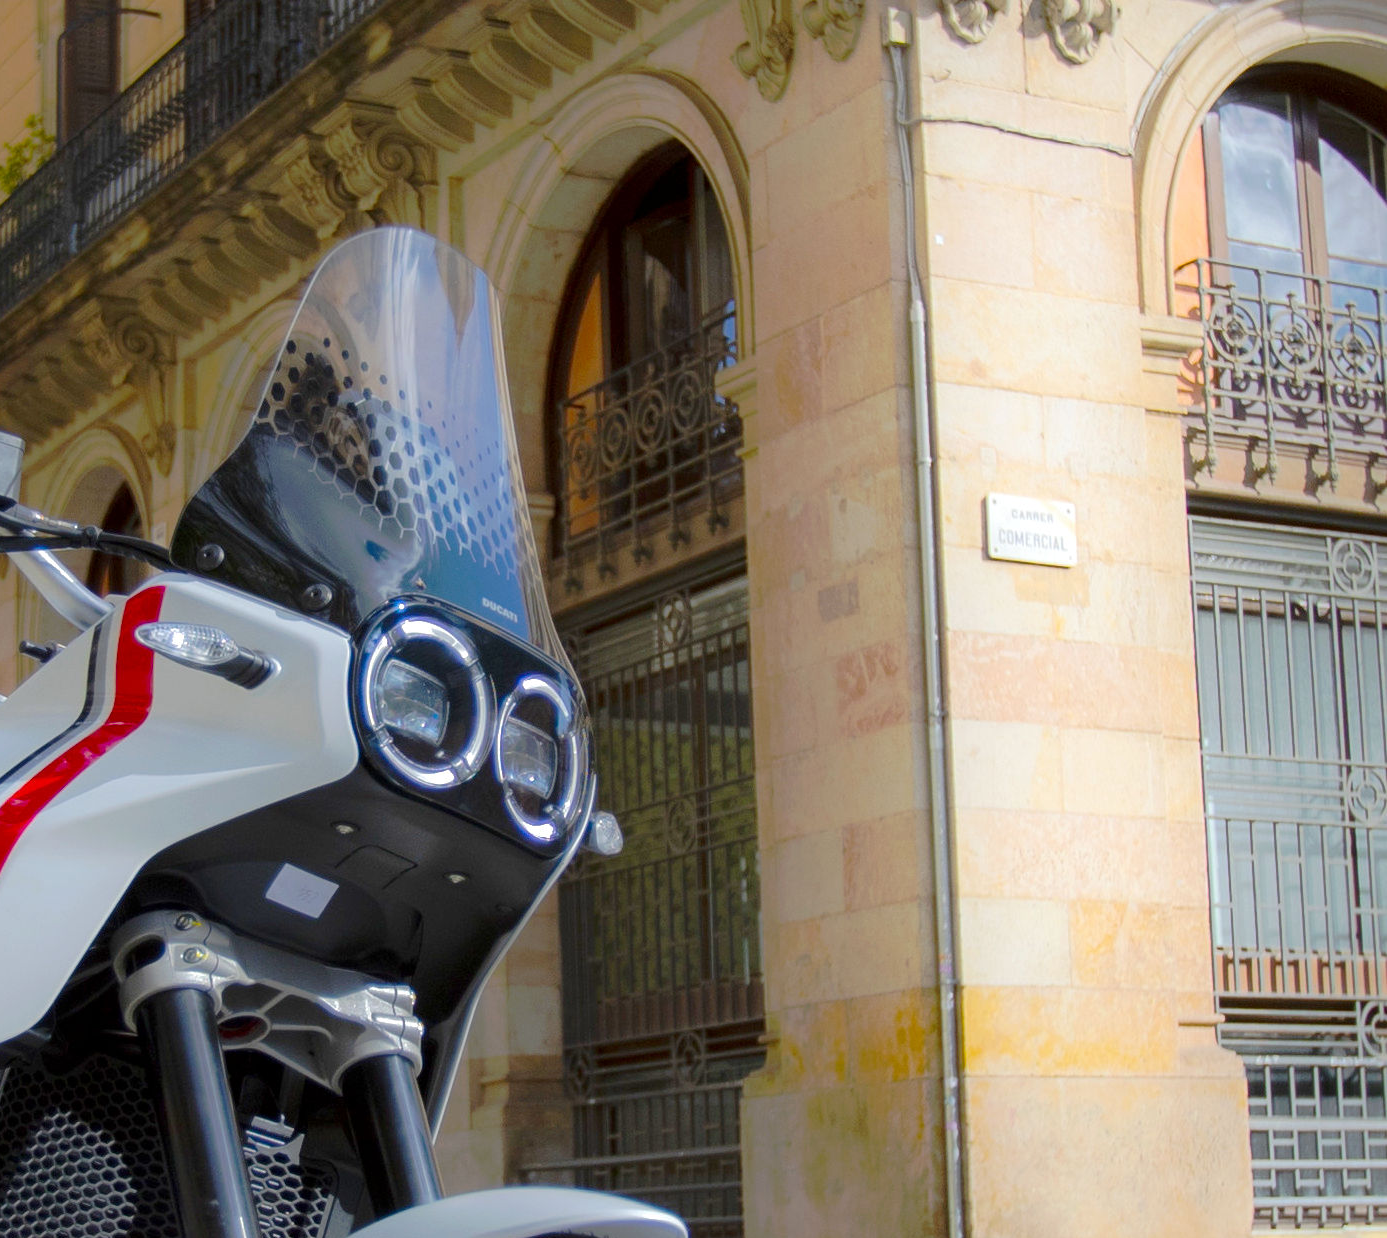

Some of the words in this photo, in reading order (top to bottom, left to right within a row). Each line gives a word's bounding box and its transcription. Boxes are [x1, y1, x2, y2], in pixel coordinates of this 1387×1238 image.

[1011, 508, 1054, 523] CARRER
[997, 528, 1069, 552] COMERCIAL
[481, 596, 518, 623] DUCATI
